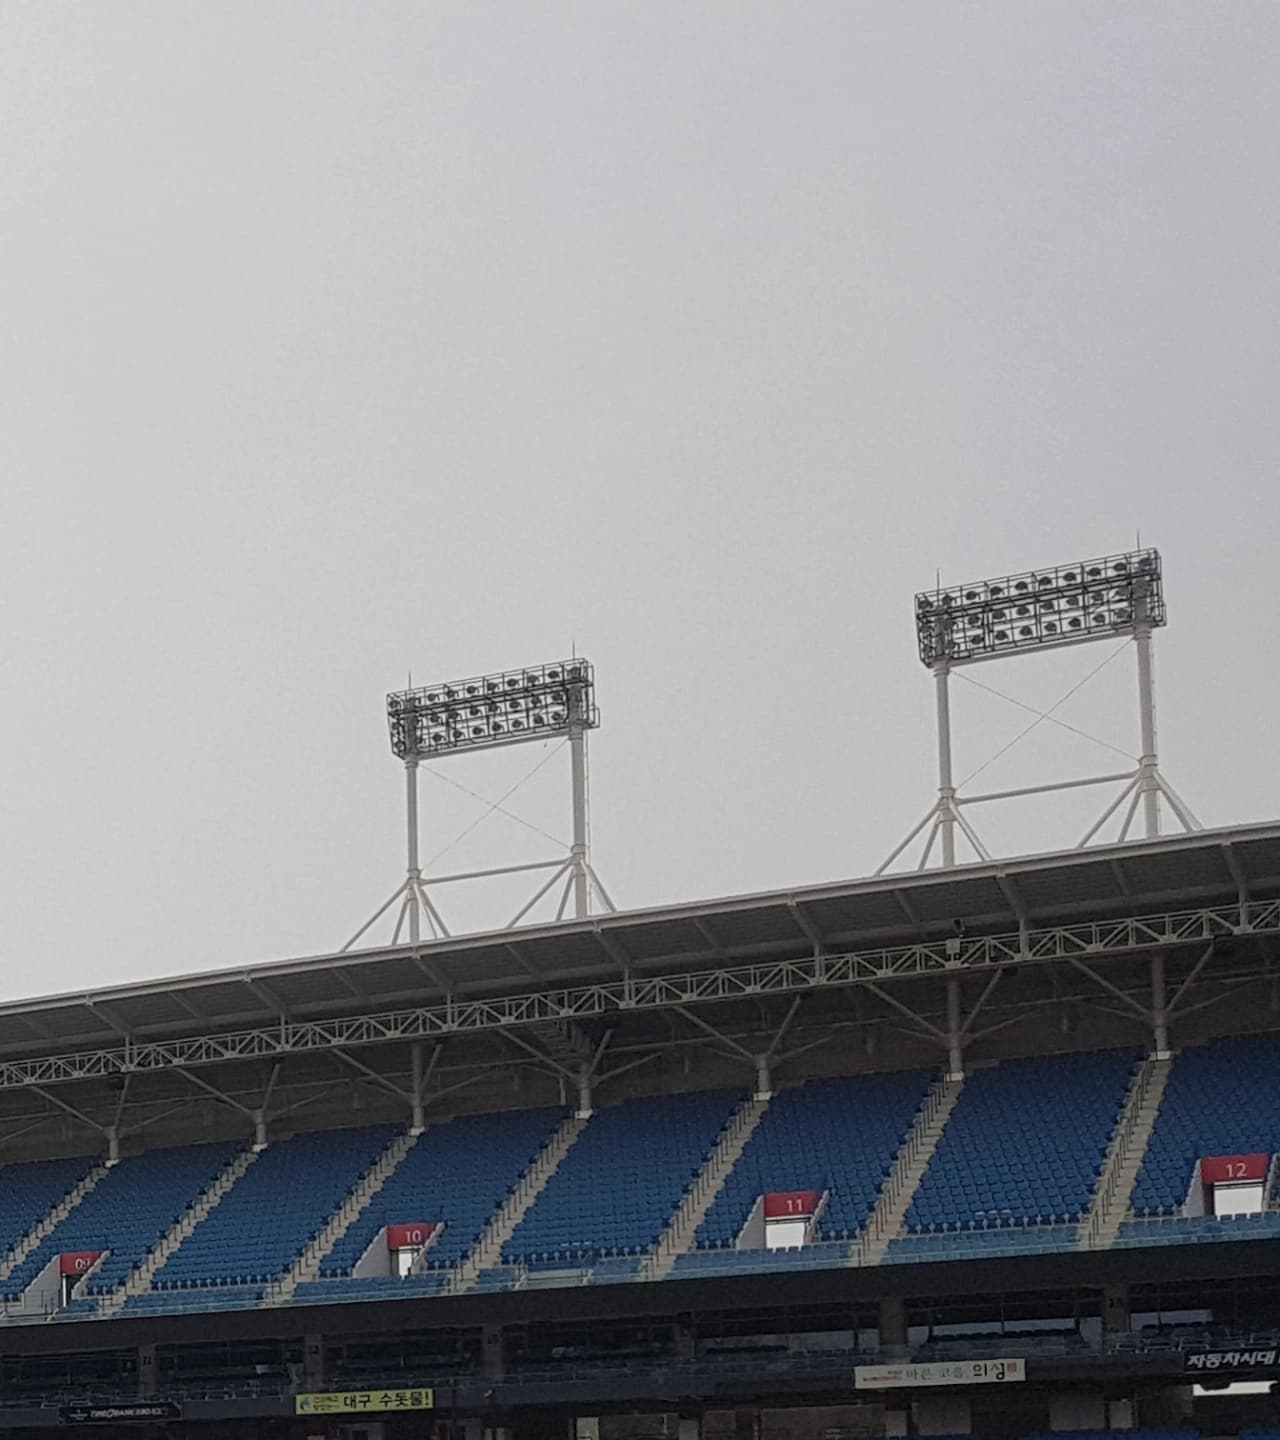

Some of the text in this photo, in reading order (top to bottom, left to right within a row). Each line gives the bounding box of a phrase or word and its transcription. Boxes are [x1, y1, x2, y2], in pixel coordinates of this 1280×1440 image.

[1225, 1162, 1248, 1178] 12
[786, 1199, 803, 1212] 11
[406, 1230, 421, 1243] 10
[1187, 1351, 1277, 1369] 자동차시대
[343, 1390, 430, 1409] 대구 수돗물!
